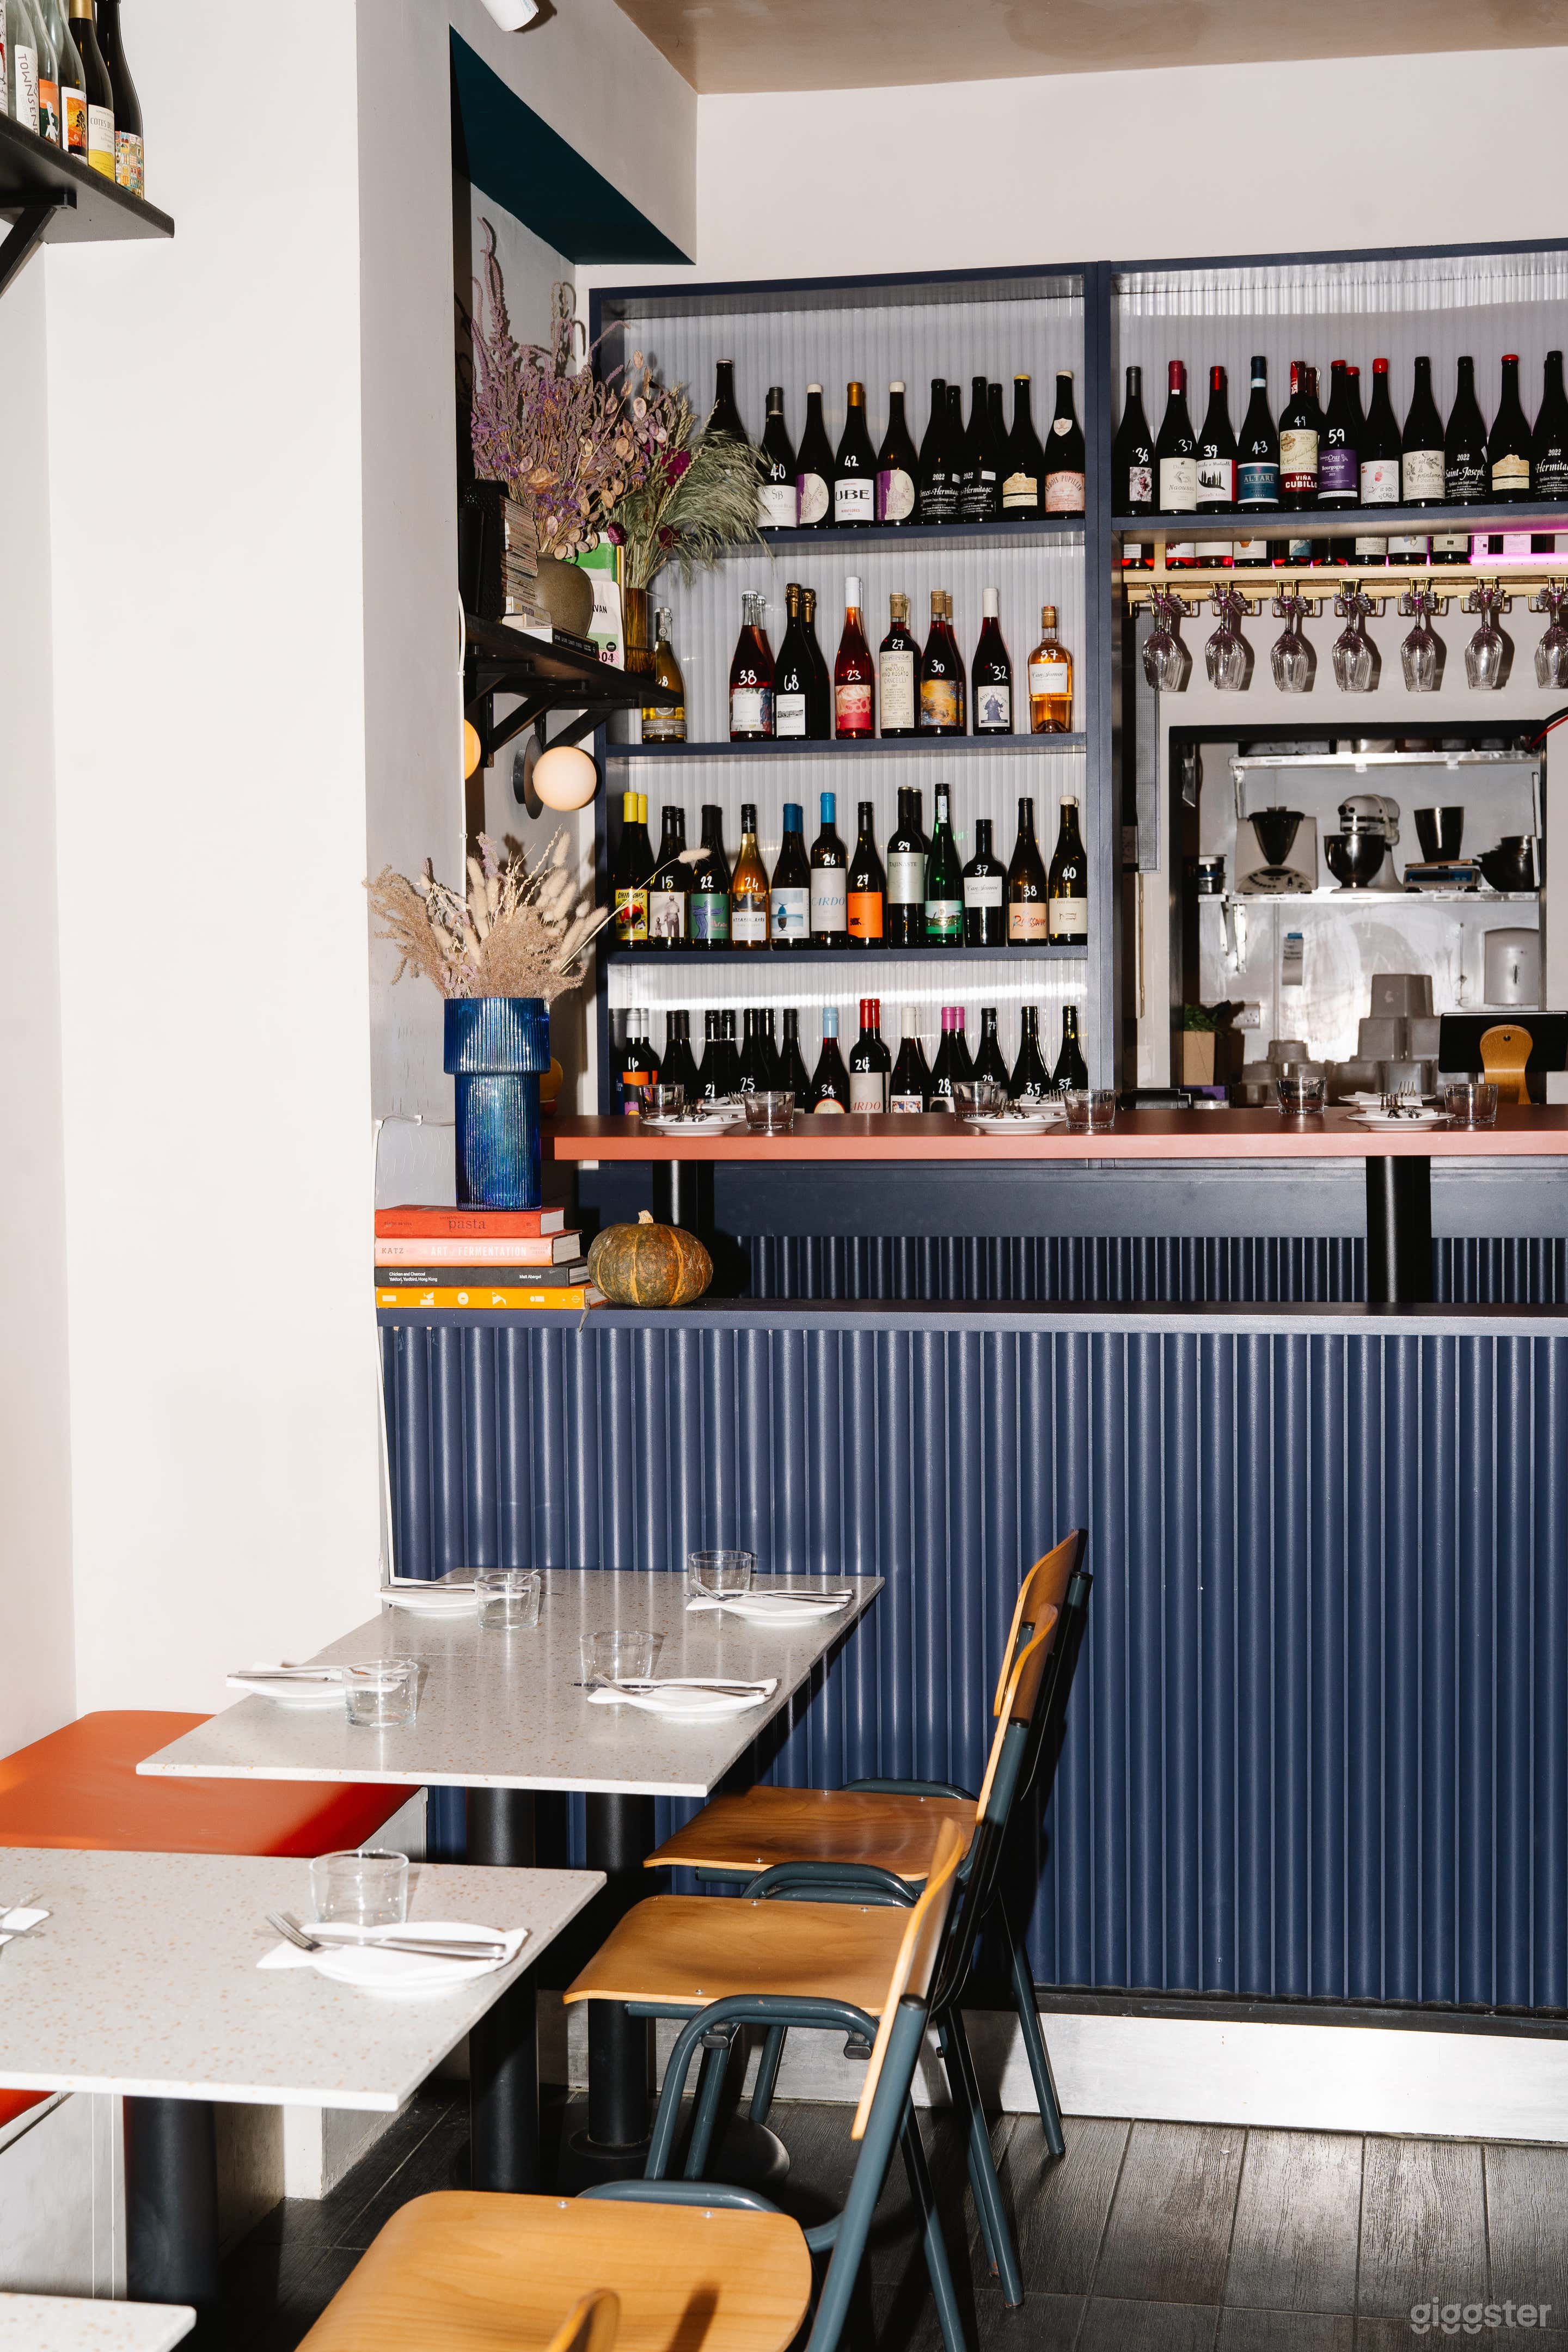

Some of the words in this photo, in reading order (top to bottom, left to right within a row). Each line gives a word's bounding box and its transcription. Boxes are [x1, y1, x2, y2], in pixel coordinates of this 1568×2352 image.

[90, 117, 107, 127] COTES
[1294, 416, 1306, 426] 49
[1328, 428, 1345, 444] 59
[1178, 439, 1192, 451] 37
[1204, 445, 1217, 458] 39
[1252, 440, 1268, 455] 43
[844, 455, 859, 467] 42
[1136, 448, 1148, 464] 36
[770, 463, 786, 481] 40
[1445, 464, 1485, 481] Saint-Joseph
[1535, 459, 1568, 475] Hermita
[1061, 475, 1082, 492] PUPILLIN
[835, 489, 870, 501] UBE
[892, 639, 904, 650] 27
[600, 652, 614, 663] 04
[1040, 650, 1058, 661] 37
[931, 660, 945, 673] 30
[992, 665, 1008, 681] 32
[738, 670, 757, 685] 38
[847, 670, 861, 681] 23
[784, 674, 799, 691] 68
[898, 841, 910, 852] 29
[823, 853, 836, 866] 26
[975, 865, 988, 875] 37
[1062, 867, 1076, 880] 40
[662, 876, 673, 889] 15
[701, 875, 714, 889] 22
[745, 877, 758, 891] 24
[857, 874, 868, 886] 27
[1024, 885, 1037, 897] 38
[628, 1056, 639, 1071] 16
[705, 1084, 715, 1095] 21
[741, 1077, 755, 1092] 25
[939, 1078, 951, 1094] 28
[1026, 1083, 1042, 1097] 35
[1058, 1077, 1071, 1090] 37
[821, 1084, 837, 1098] 34
[853, 1101, 881, 1111] IRDO
[449, 1218, 486, 1230] pasta
[431, 1246, 448, 1256] ART
[458, 1246, 527, 1256] FERMENTATION
